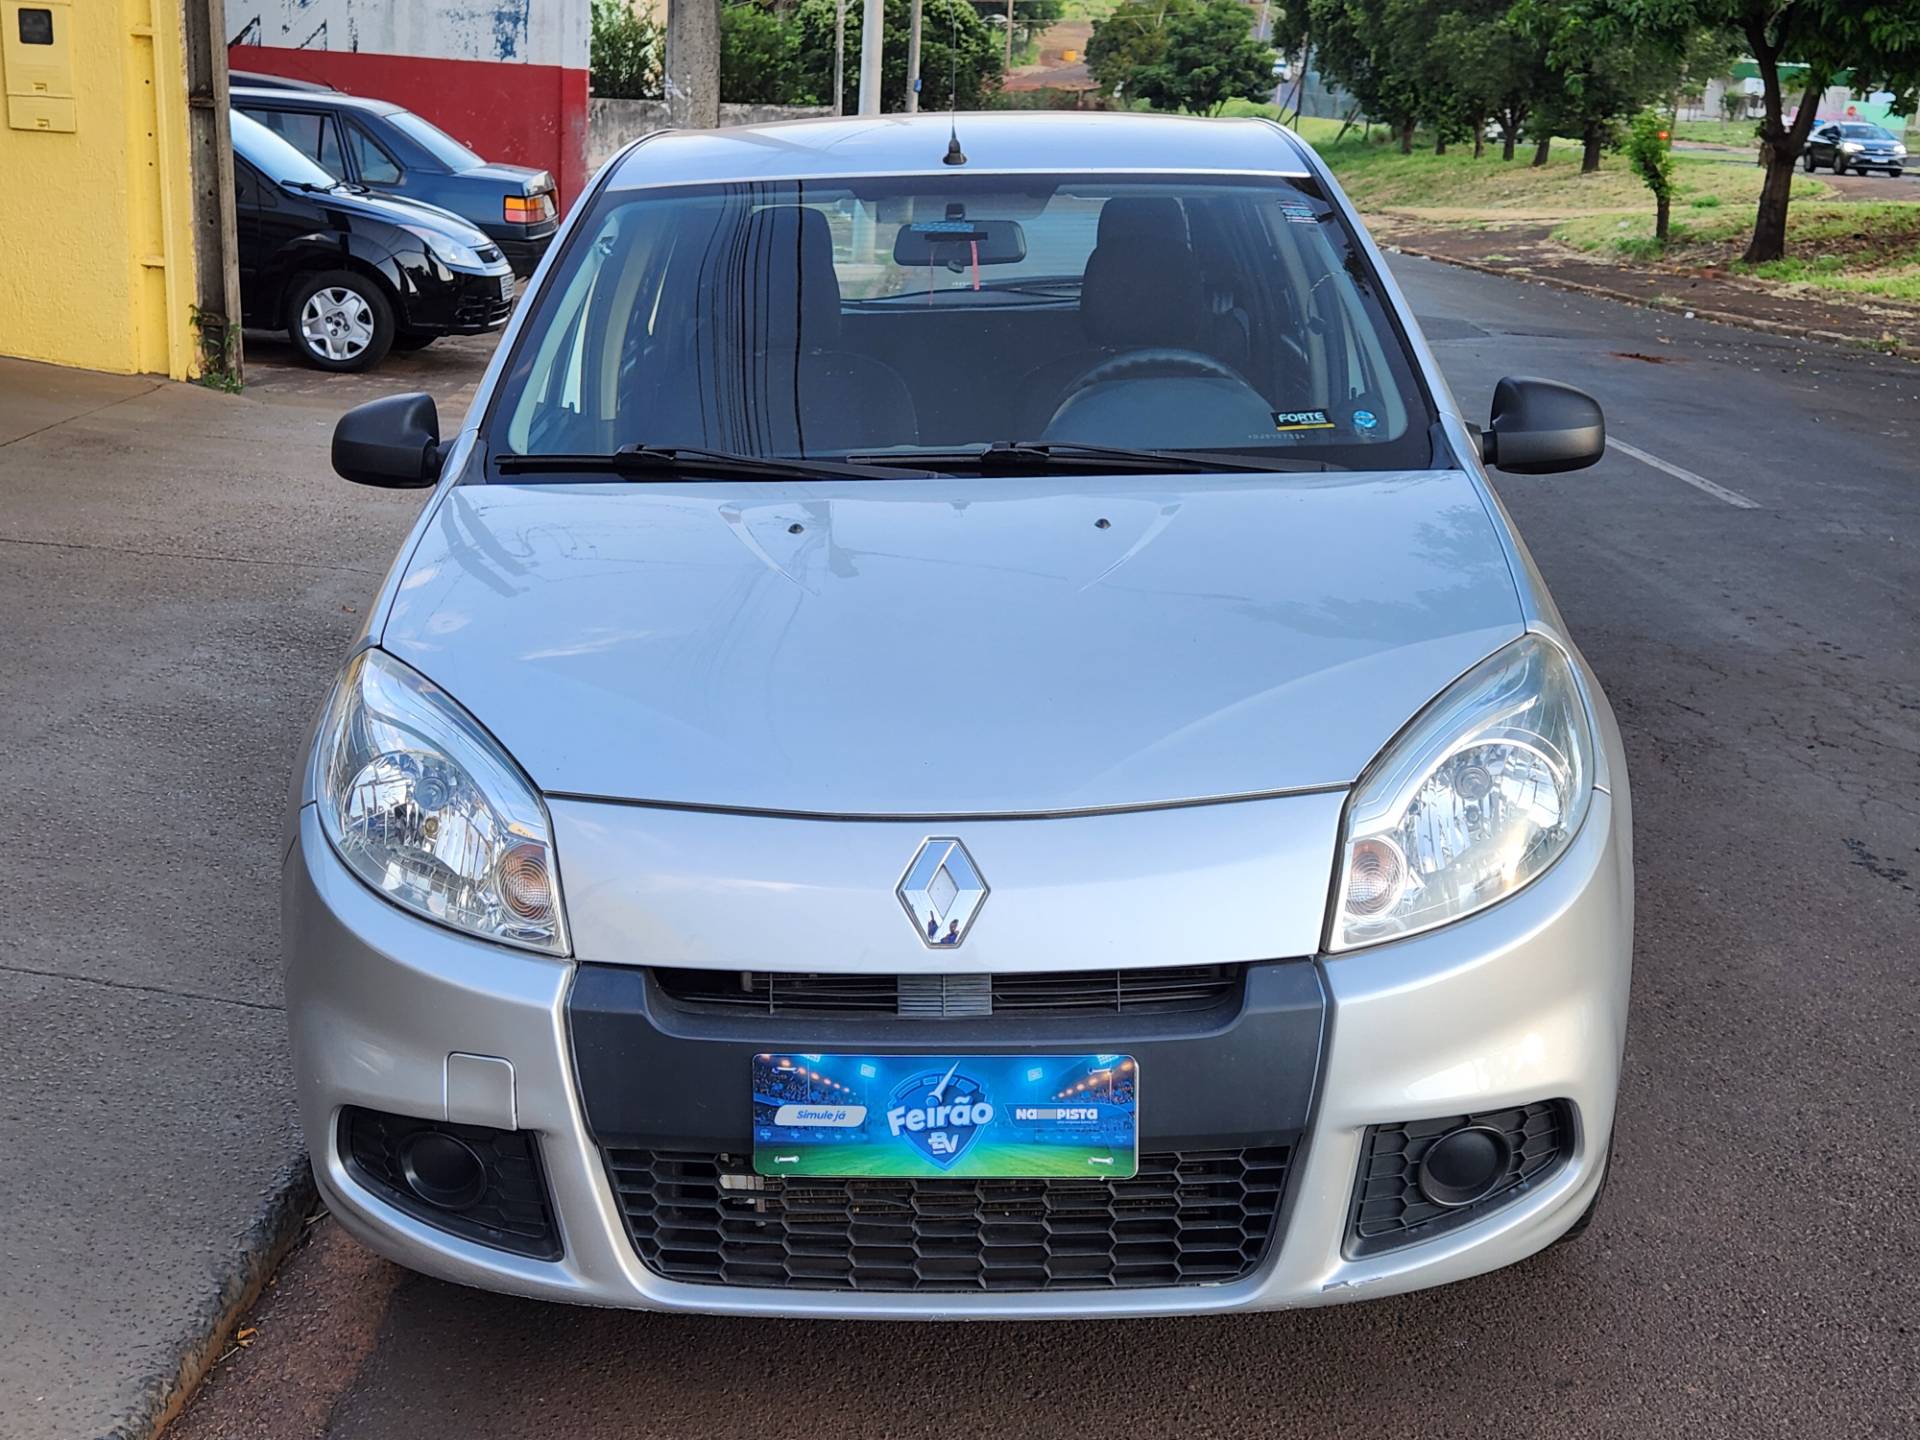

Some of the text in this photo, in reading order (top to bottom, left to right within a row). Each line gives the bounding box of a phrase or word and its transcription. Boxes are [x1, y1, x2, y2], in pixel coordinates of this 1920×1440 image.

[1278, 411, 1324, 423] FORTE
[796, 1110, 847, 1122] Simule já
[887, 1095, 994, 1137] Feirão
[927, 1131, 960, 1155] BV
